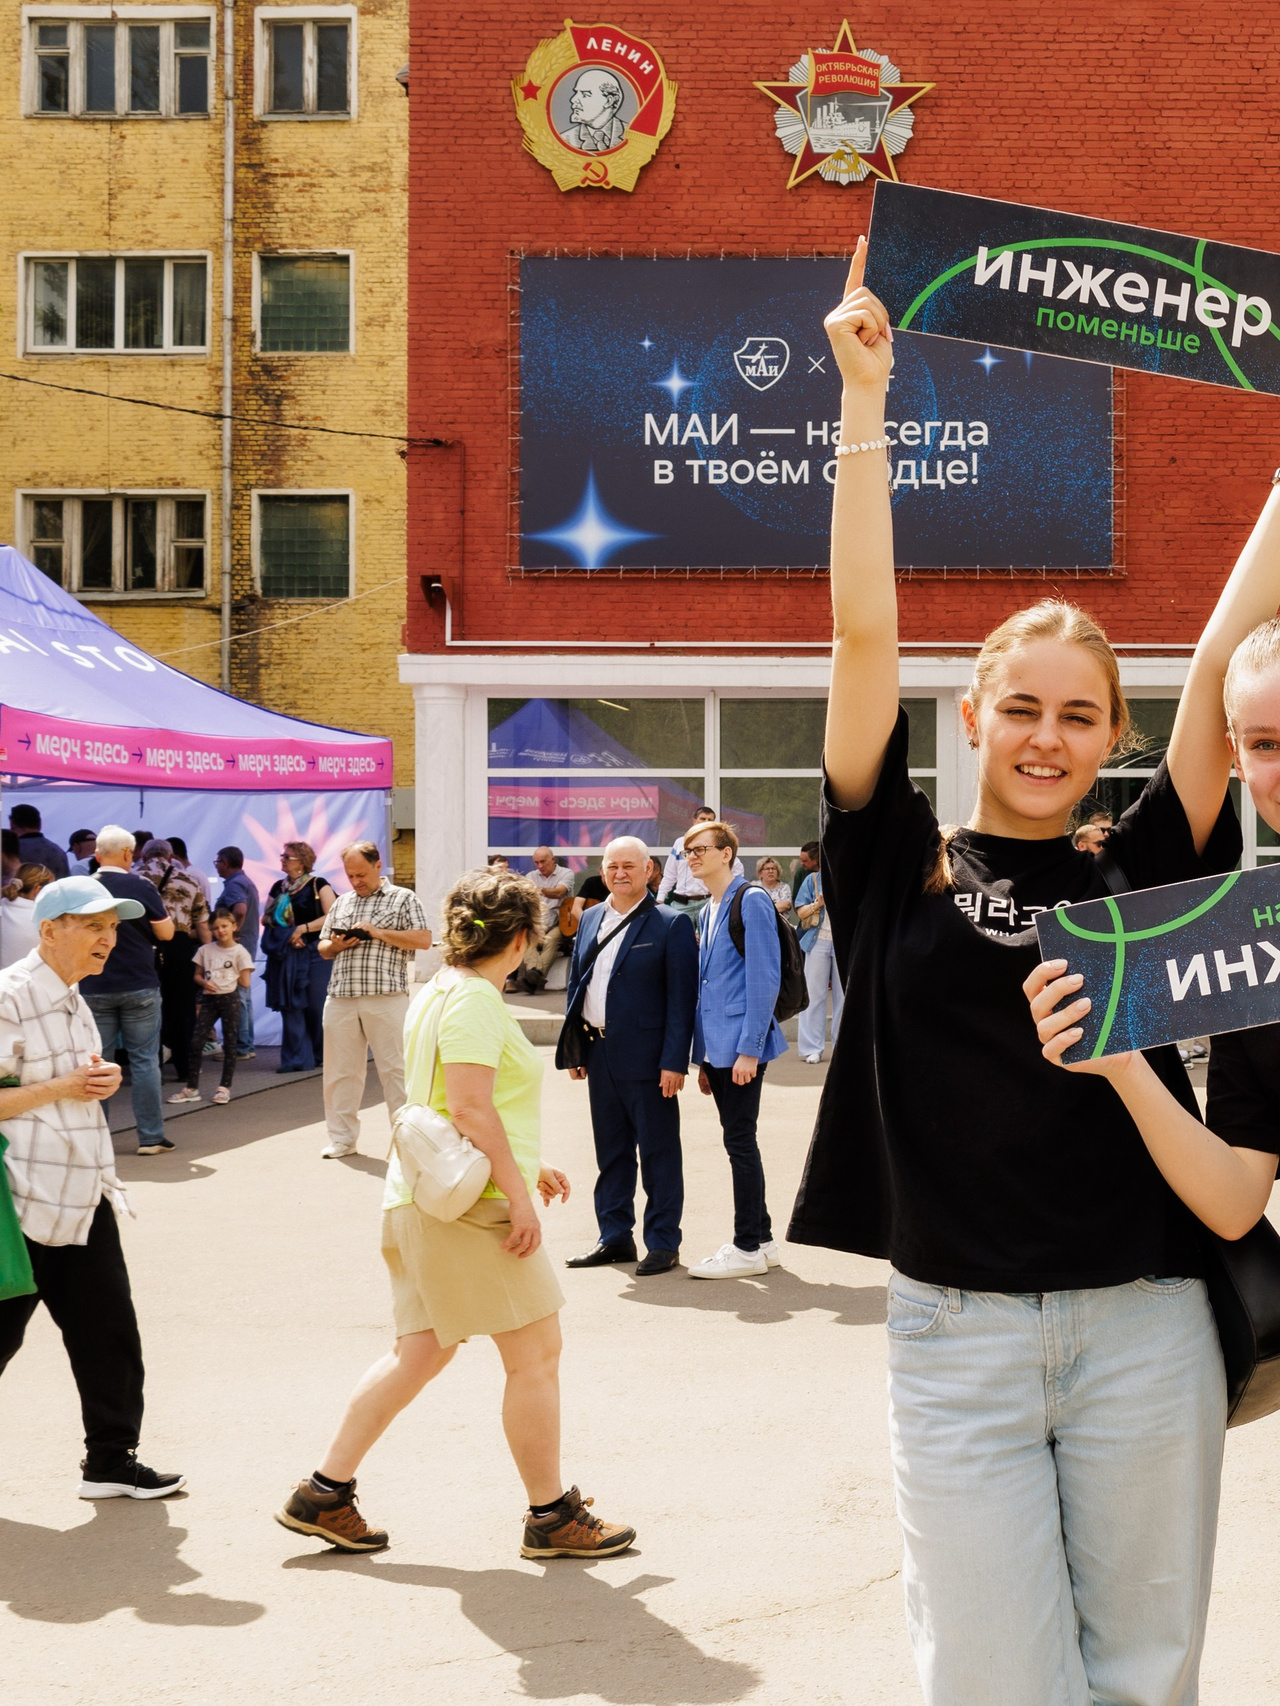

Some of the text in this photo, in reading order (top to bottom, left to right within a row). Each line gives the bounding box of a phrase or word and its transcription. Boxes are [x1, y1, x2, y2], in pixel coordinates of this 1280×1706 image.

[586, 37, 655, 75] ЛЕНИН
[816, 61, 880, 77] ОКТЯБРЬСКАЯ
[818, 74, 876, 89] РЕВОЛЮЦИЯ
[974, 245, 1272, 346] инженер
[1036, 307, 1201, 354] поменьше
[644, 413, 738, 446] МАИ
[806, 420, 989, 452] насегда
[654, 450, 979, 491] в твоём сдце!
[35, 733, 376, 778] мерч здесь мерч здесь мерч здесь мерч здесь
[954, 891, 1072, 926] 뭐라고
